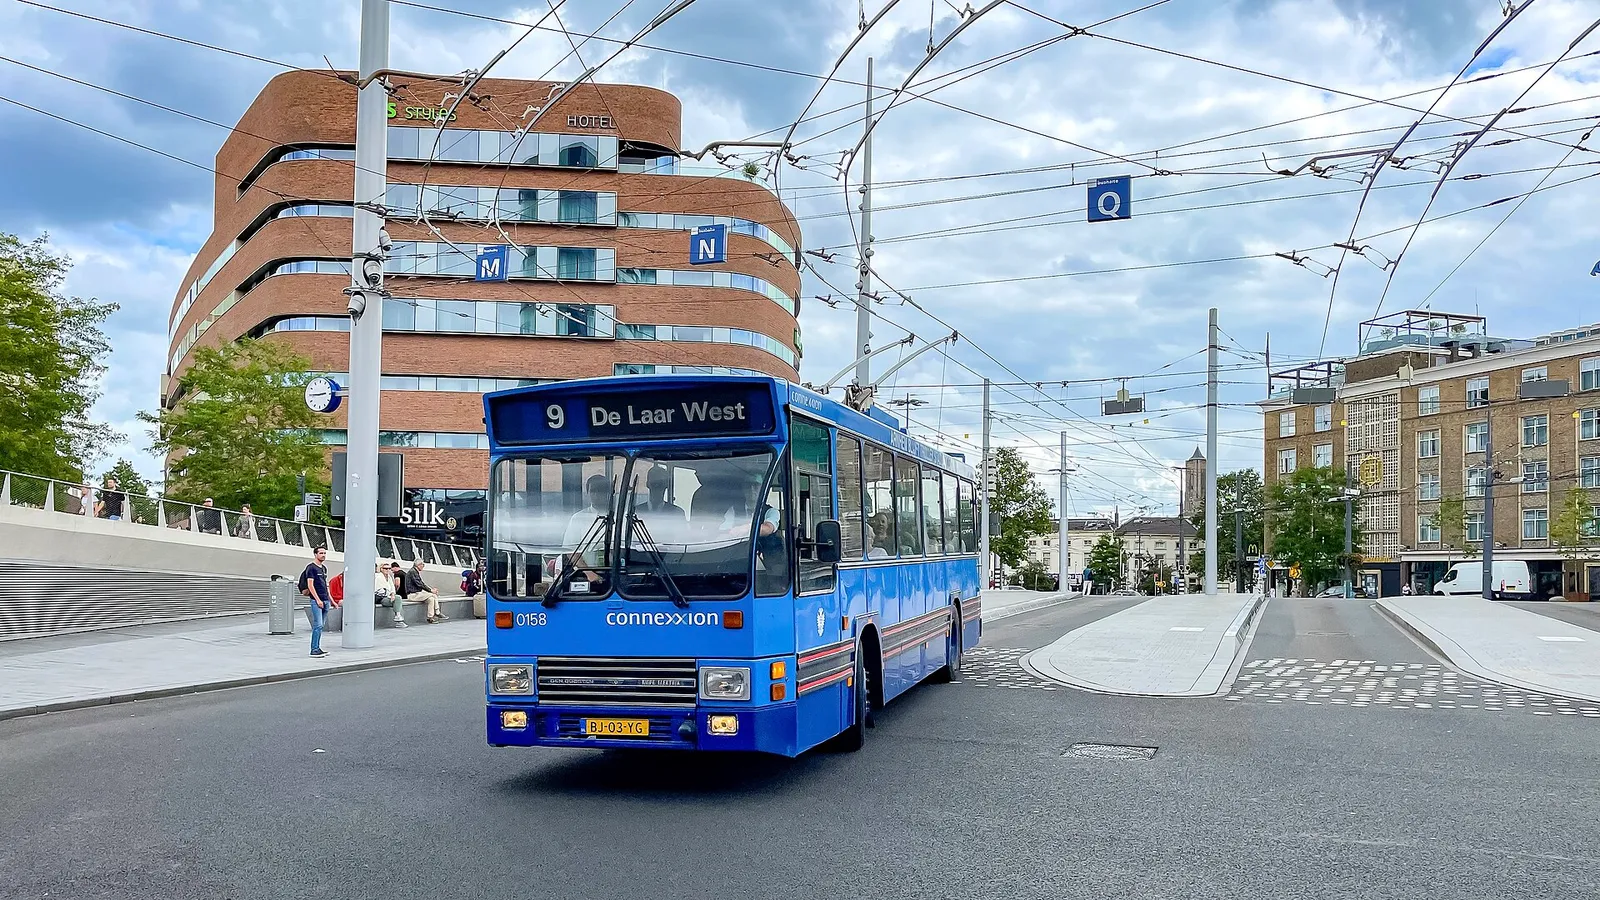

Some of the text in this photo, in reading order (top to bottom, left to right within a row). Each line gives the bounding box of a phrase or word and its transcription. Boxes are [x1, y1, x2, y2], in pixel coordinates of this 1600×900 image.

[567, 115, 617, 128] HOTEL
[1097, 191, 1121, 218] Q
[698, 238, 715, 260] N
[481, 258, 500, 278] M
[546, 401, 746, 429] 9 De Laar West
[399, 501, 445, 525] silk
[516, 612, 547, 626] 0158
[606, 612, 719, 626] connexxion
[590, 721, 643, 734] BJ-03-YG
